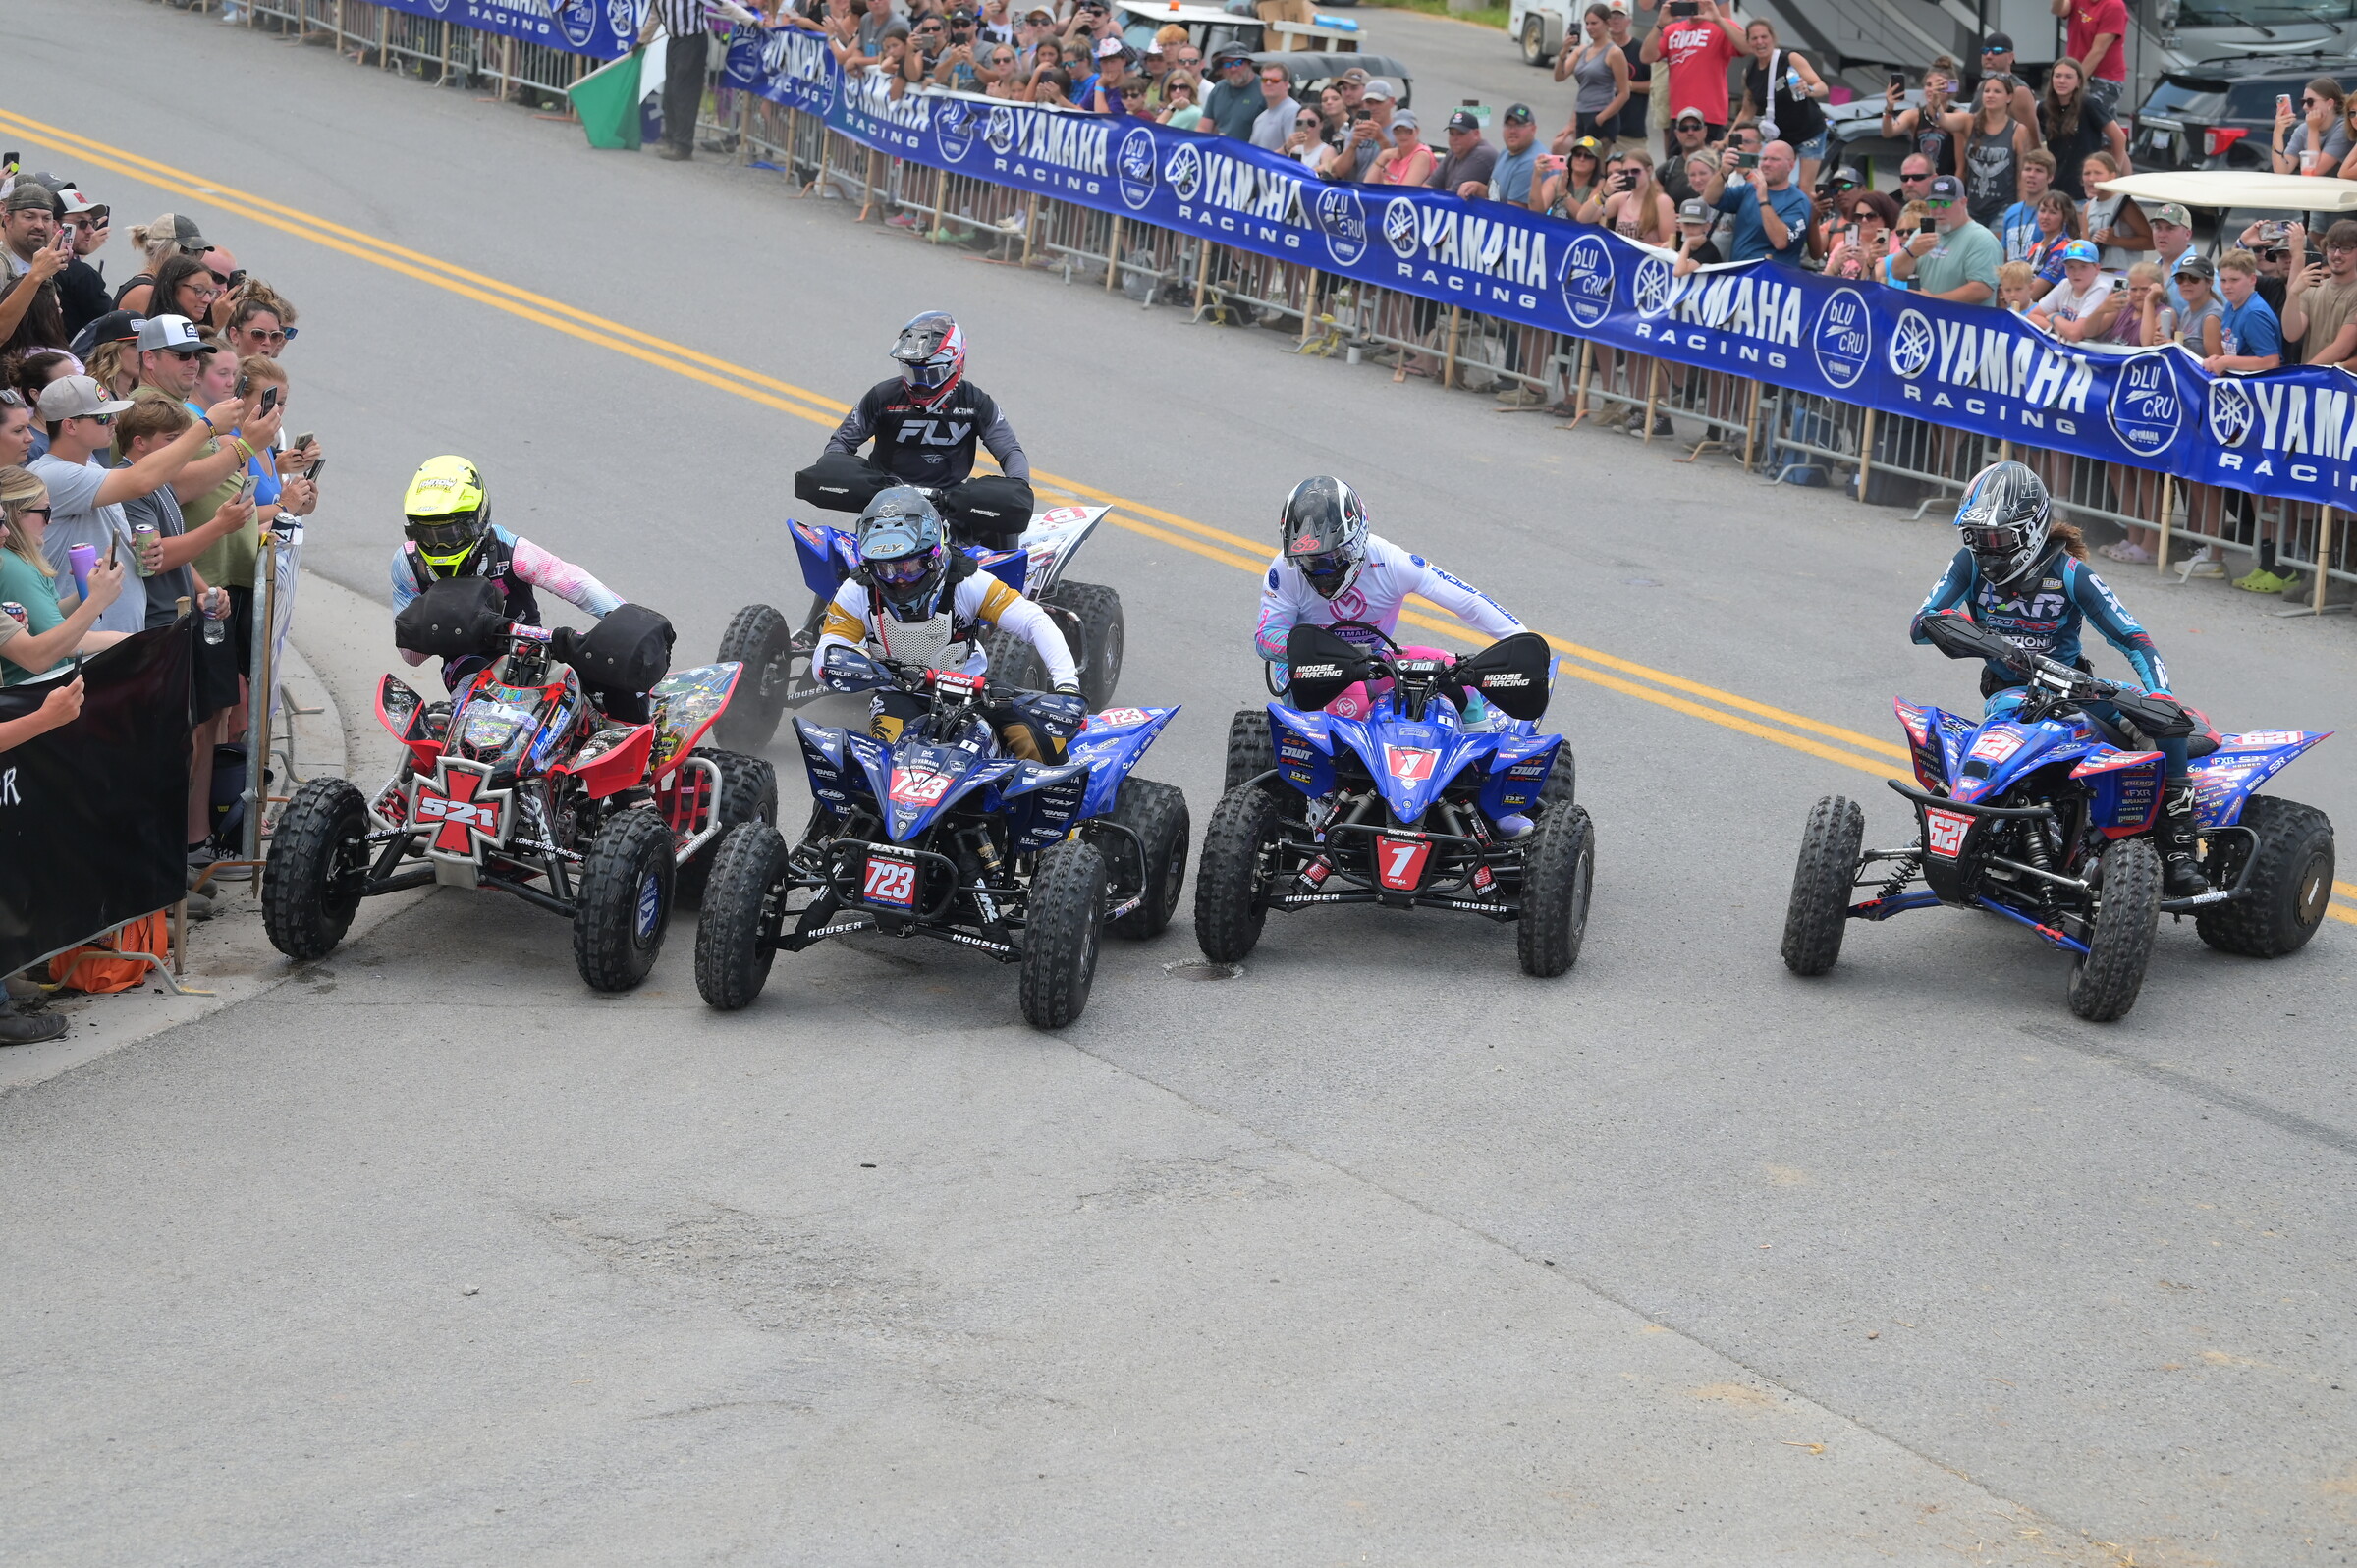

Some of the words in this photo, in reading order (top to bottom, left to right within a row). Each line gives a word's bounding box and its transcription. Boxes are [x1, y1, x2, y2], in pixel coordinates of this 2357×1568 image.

[469, 6, 550, 34] RACING
[1669, 29, 1711, 50] RIDE
[846, 114, 919, 148] RACING
[1017, 108, 1108, 177] YAMAHA
[994, 157, 1100, 195] RACING
[1204, 151, 1312, 231] YAMAHA
[1178, 204, 1300, 248] RACING
[1422, 205, 1548, 290] YAMAHA
[1398, 261, 1537, 310] RACING
[1667, 274, 1803, 348] YAMAHA
[1635, 323, 1787, 369] RACING
[1936, 318, 2095, 414] YAMAHA
[1904, 383, 2077, 436] RACING
[896, 419, 971, 446] FLY
[2219, 452, 2357, 492] RACI
[870, 543, 904, 555] FLY
[1987, 617, 2013, 626] PRO
[2013, 620, 2059, 632] RACE
[828, 669, 852, 677] FOWLER
[936, 673, 976, 687] FASST
[1296, 664, 1335, 674] MOOSE
[1300, 670, 1343, 678] RACING
[788, 686, 829, 700] HOUSER
[1049, 714, 1073, 724] FOWLER
[1101, 708, 1144, 726] 723
[1281, 746, 1313, 760] DWT
[1282, 738, 1308, 747] CST
[1969, 733, 2021, 764] 621
[1398, 754, 1424, 776] 1
[1510, 766, 1545, 775] DWT
[0, 766, 21, 807] R
[891, 771, 949, 799] 723
[419, 797, 494, 827] 521
[1928, 814, 1968, 852] 621
[516, 838, 534, 846] LONE
[534, 841, 555, 851] STAR
[556, 847, 582, 860] RACING
[1392, 846, 1417, 877] 1
[863, 861, 915, 899] 723
[1298, 873, 1318, 890] Elka
[1476, 883, 1498, 895] Elka
[1285, 893, 1340, 902] HOUSER
[1453, 900, 1507, 912] HOUSER
[808, 921, 862, 938] HOUSER
[952, 933, 1010, 952] HOUSER
